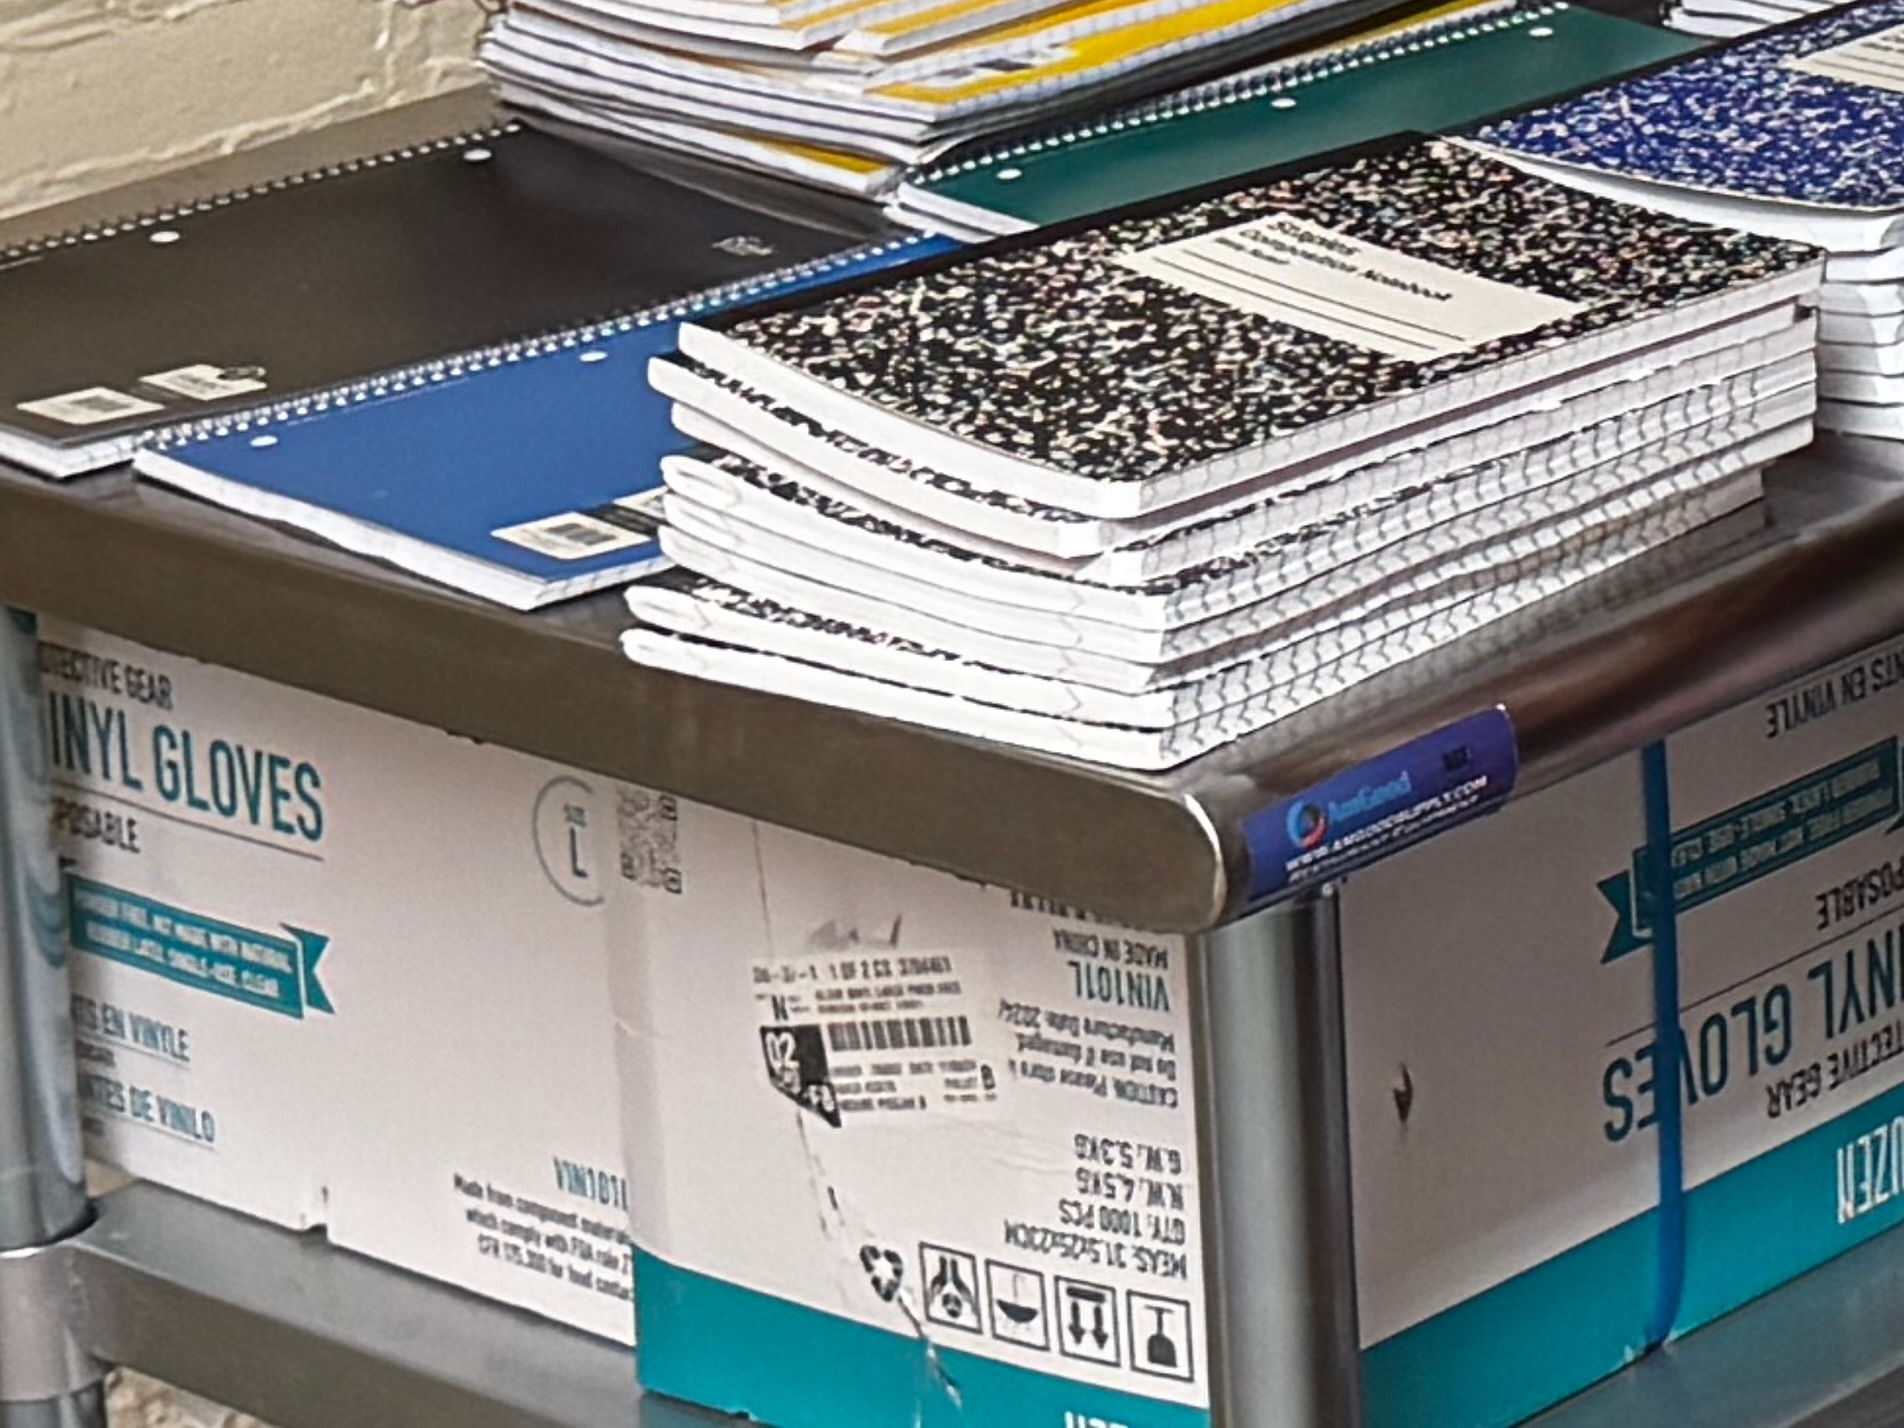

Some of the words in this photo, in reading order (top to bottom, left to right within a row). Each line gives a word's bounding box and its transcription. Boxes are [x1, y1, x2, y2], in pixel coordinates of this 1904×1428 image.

[125, 662, 173, 711] GEAR
[1765, 682, 1837, 739] VINYLE
[1841, 664, 1867, 705] EN
[48, 688, 143, 791] INYL
[152, 723, 324, 842] GLOVES
[49, 797, 141, 854] POSABLE
[1066, 959, 1170, 1013] VIN101L
[1766, 1062, 1822, 1120] GEAR
[1058, 1197, 1095, 1230] PCS
[1100, 1204, 1142, 1239] 1000
